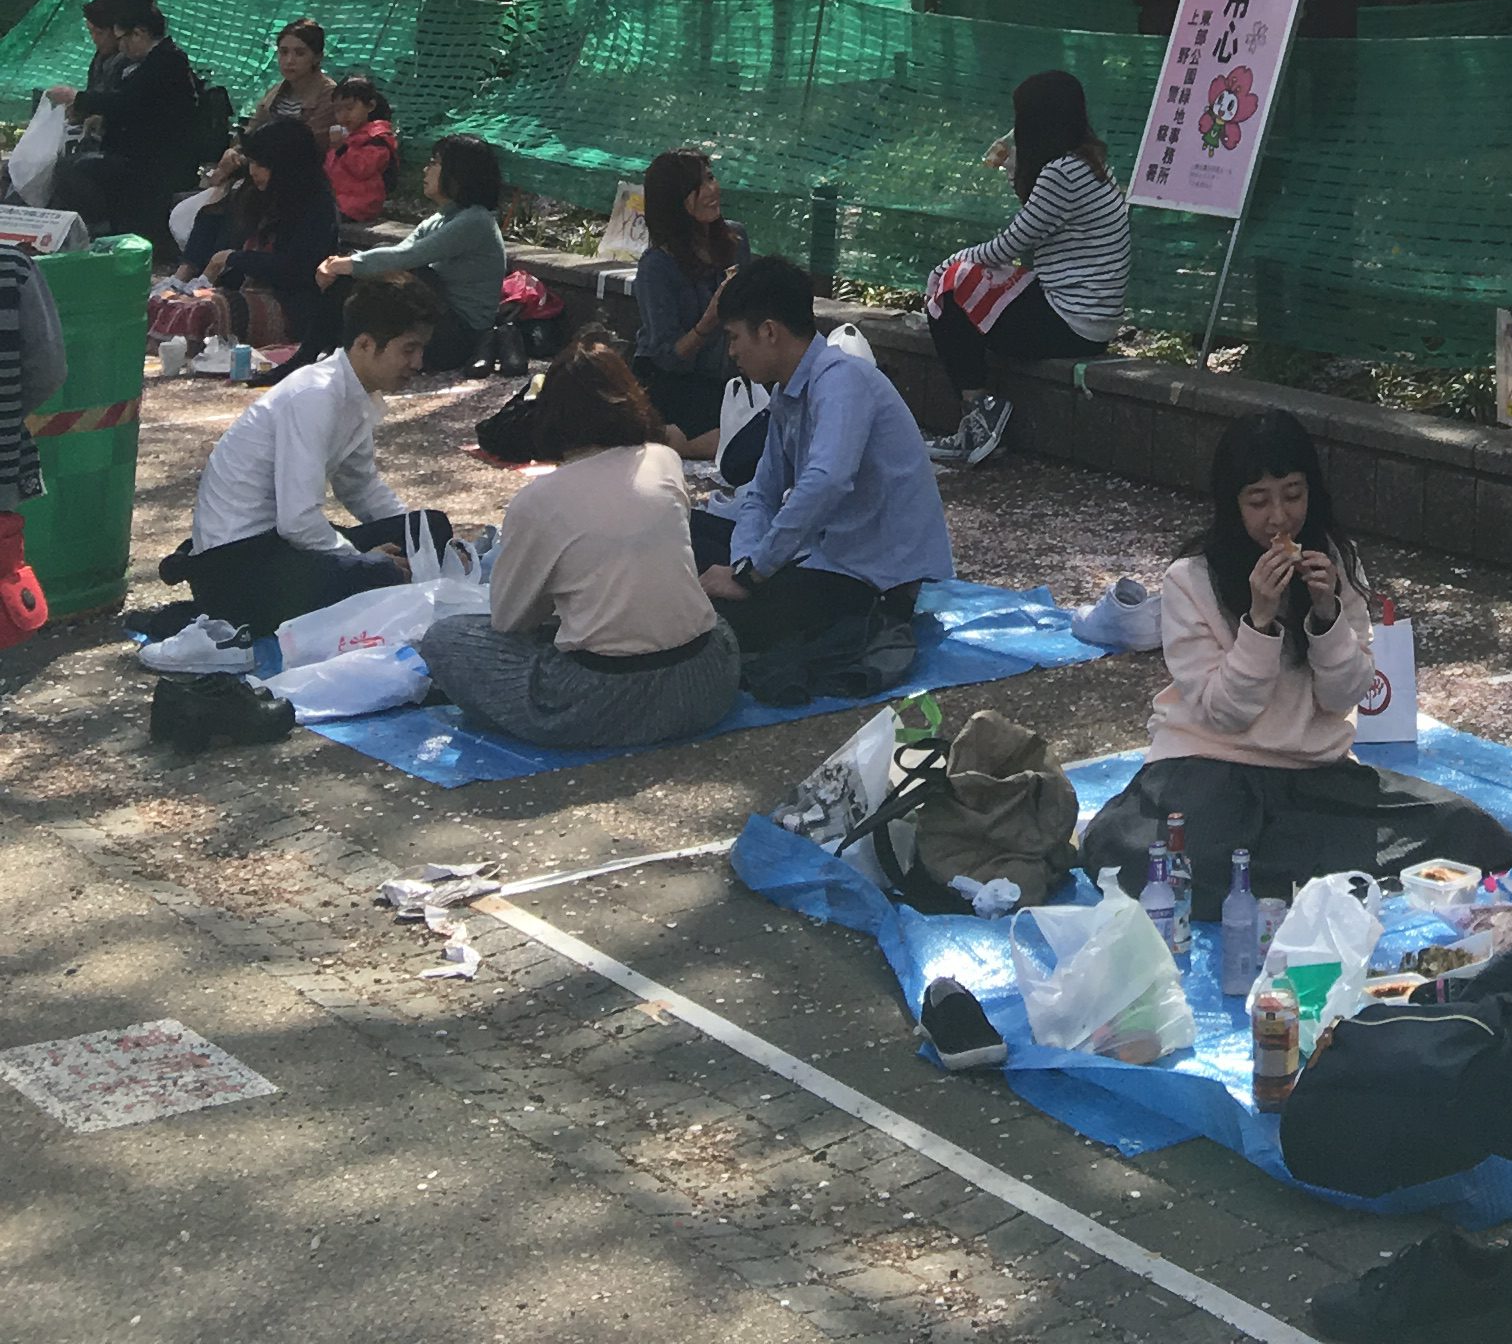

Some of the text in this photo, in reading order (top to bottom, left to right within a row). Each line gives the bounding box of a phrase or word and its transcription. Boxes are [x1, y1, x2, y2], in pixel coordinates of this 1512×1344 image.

[1146, 8, 1200, 183] 上野警察署
[1155, 10, 1213, 185] 東部公園緑地事務所
